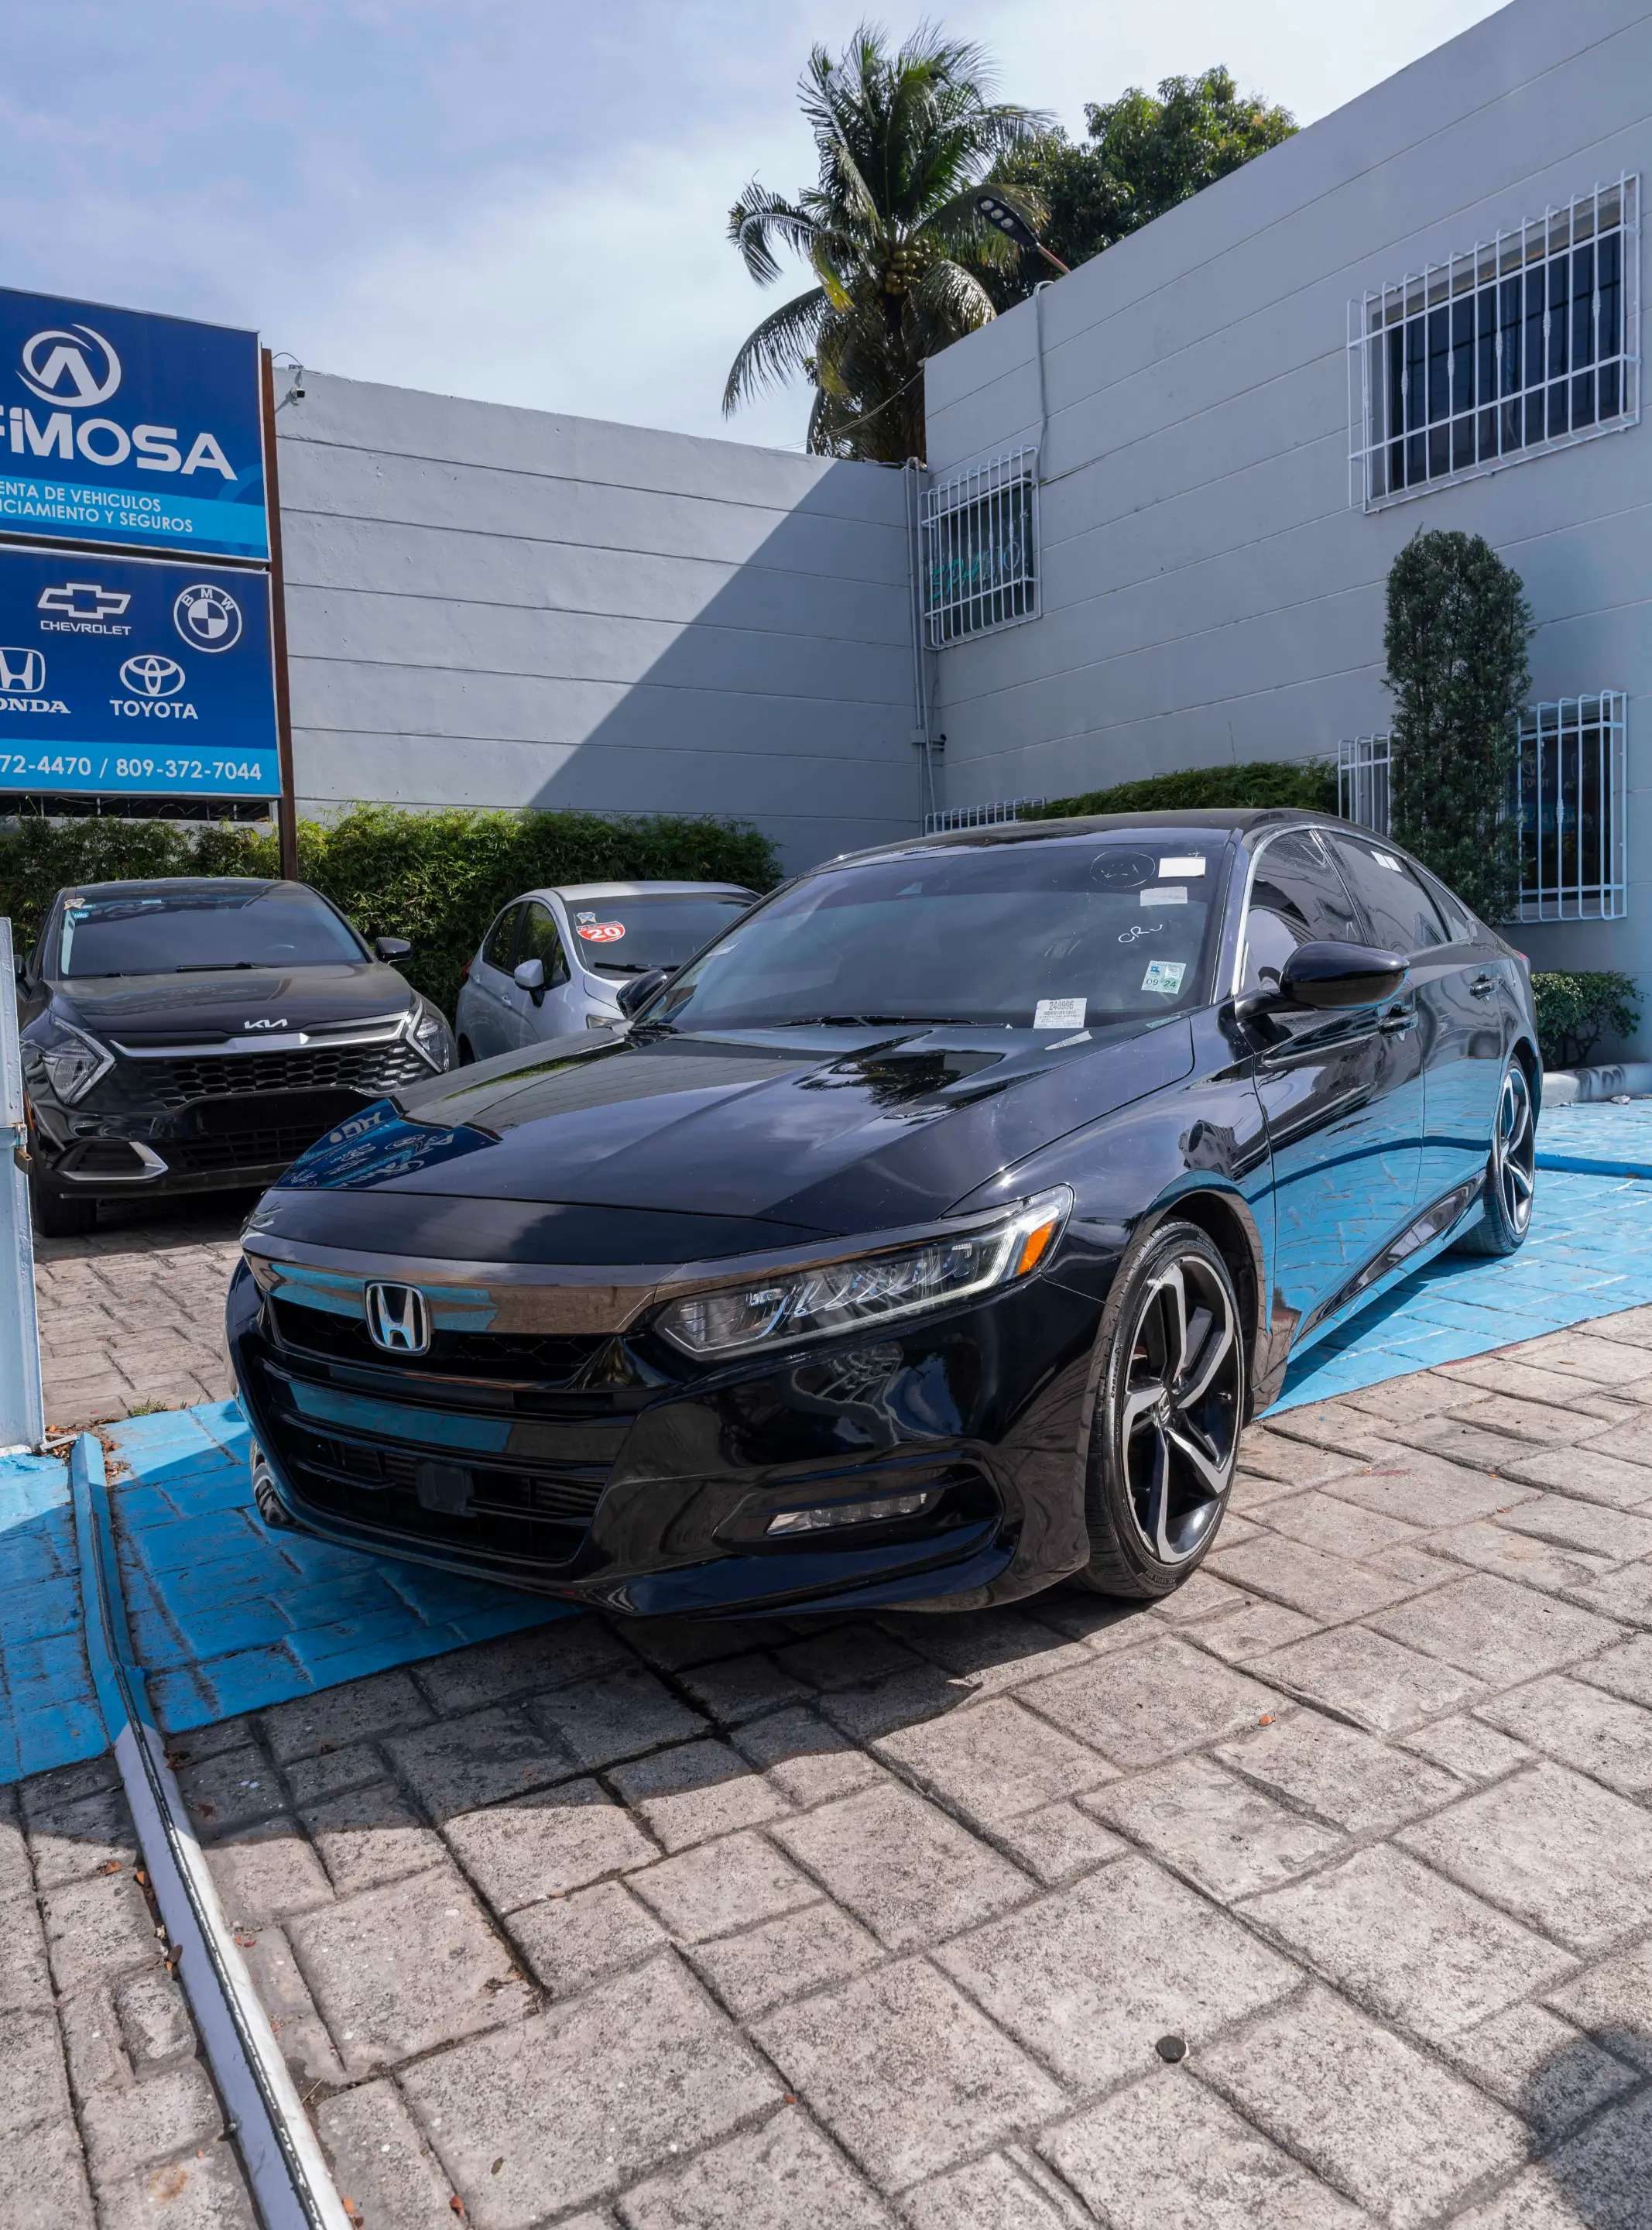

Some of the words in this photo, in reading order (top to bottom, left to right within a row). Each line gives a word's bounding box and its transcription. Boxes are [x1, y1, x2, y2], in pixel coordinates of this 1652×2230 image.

[0, 405, 238, 481] iMOSA
[44, 485, 66, 501] DE
[70, 489, 161, 513] VEHICULOS
[0, 498, 99, 522] CIAMIENTO
[105, 509, 114, 523] Y
[119, 512, 193, 533] SEGUROS
[181, 588, 235, 611] BMW
[40, 620, 132, 636] CHEVROLET
[109, 700, 199, 719] TOYOTA
[0, 754, 91, 776] 72-4470
[116, 758, 262, 780] 809-372-7044
[587, 927, 621, 939] 20
[1164, 979, 1176, 988] 24
